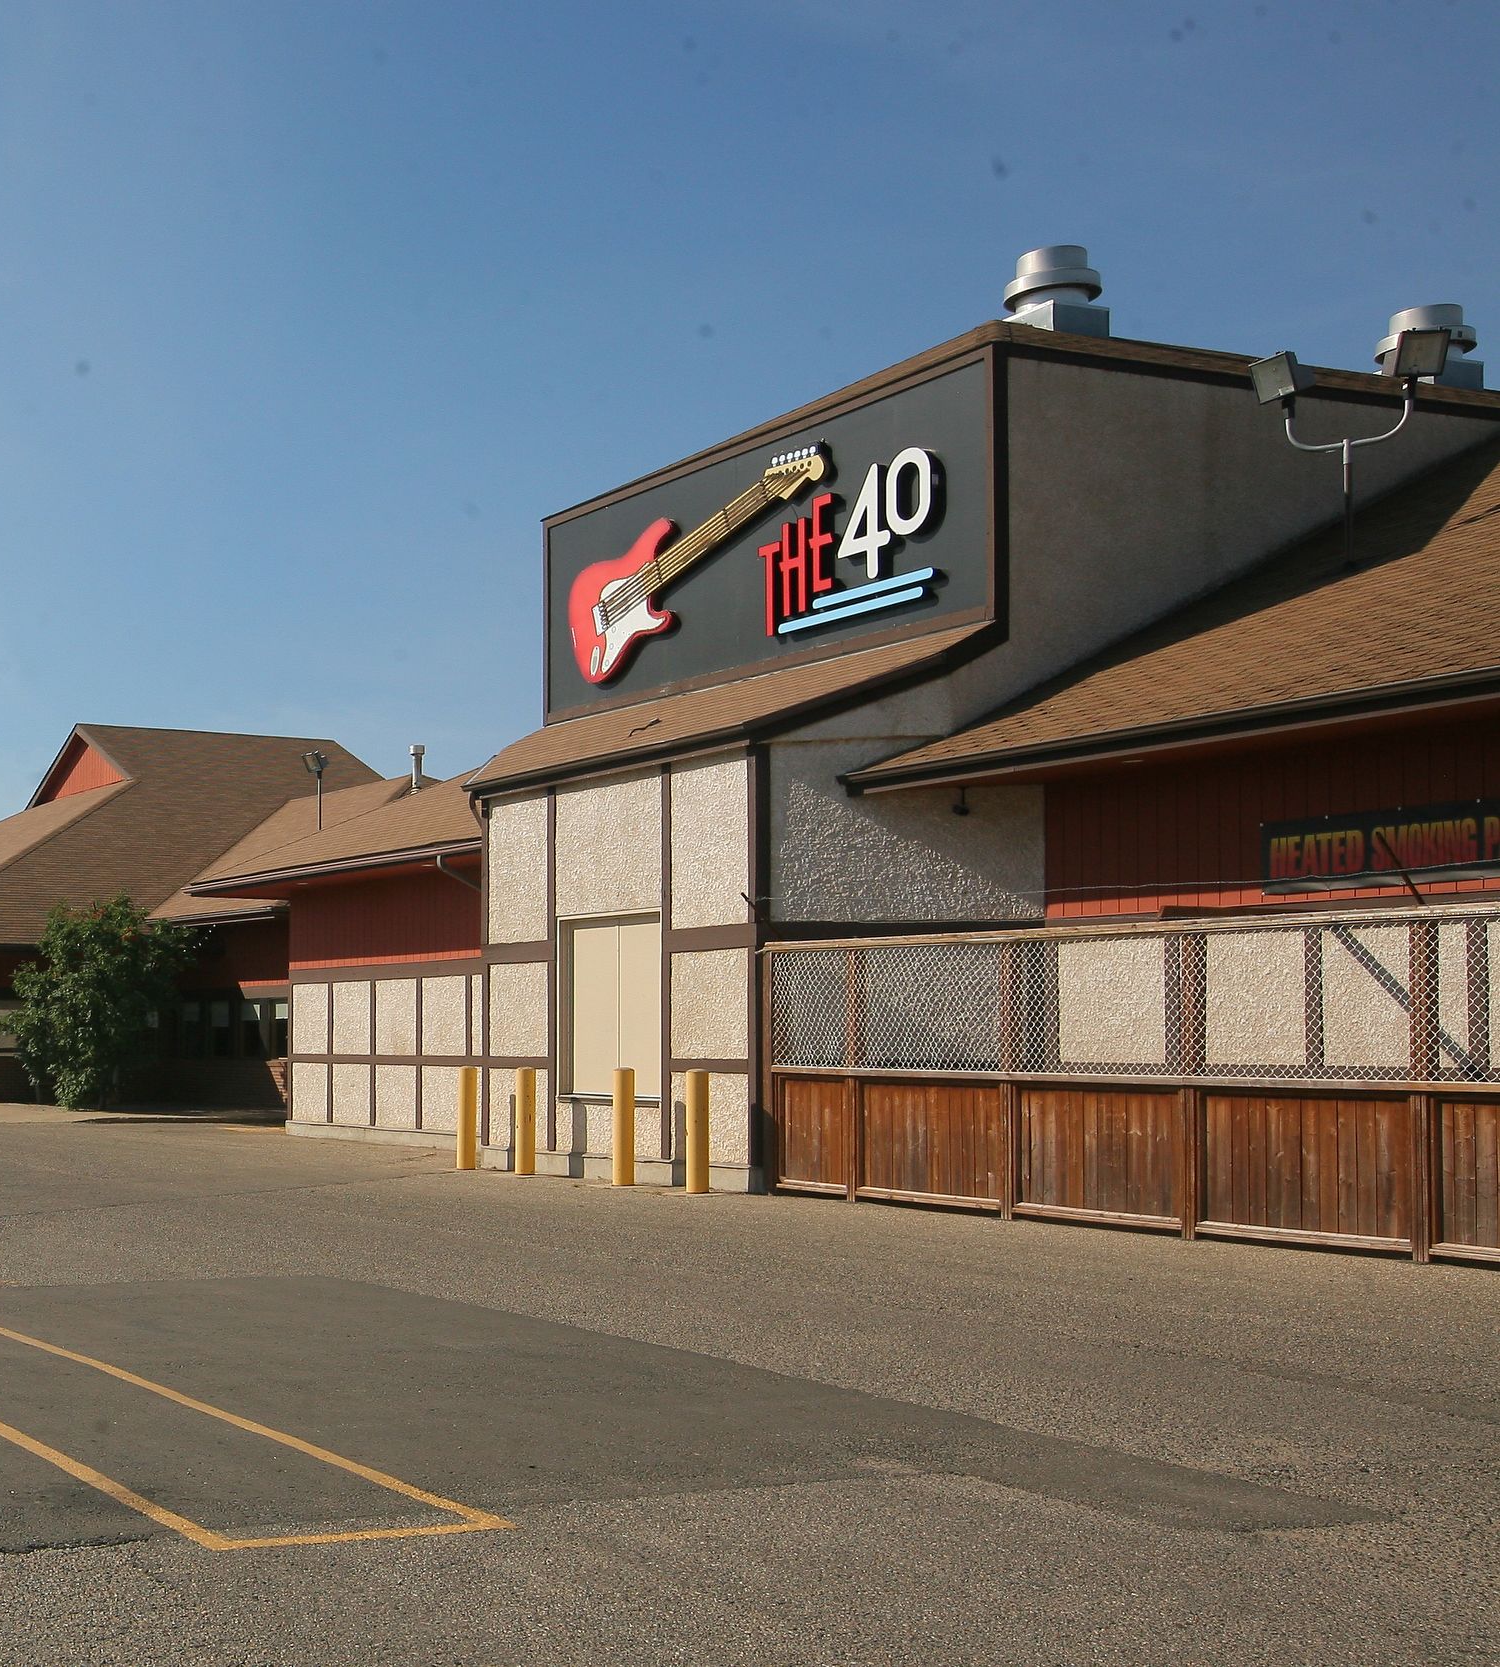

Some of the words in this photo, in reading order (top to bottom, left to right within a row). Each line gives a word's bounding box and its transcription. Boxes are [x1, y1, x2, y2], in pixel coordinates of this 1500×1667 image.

[757, 492, 833, 637] THE
[836, 446, 931, 579] 40
[1269, 829, 1365, 879] HEATED
[1371, 817, 1478, 872] SMOKING
